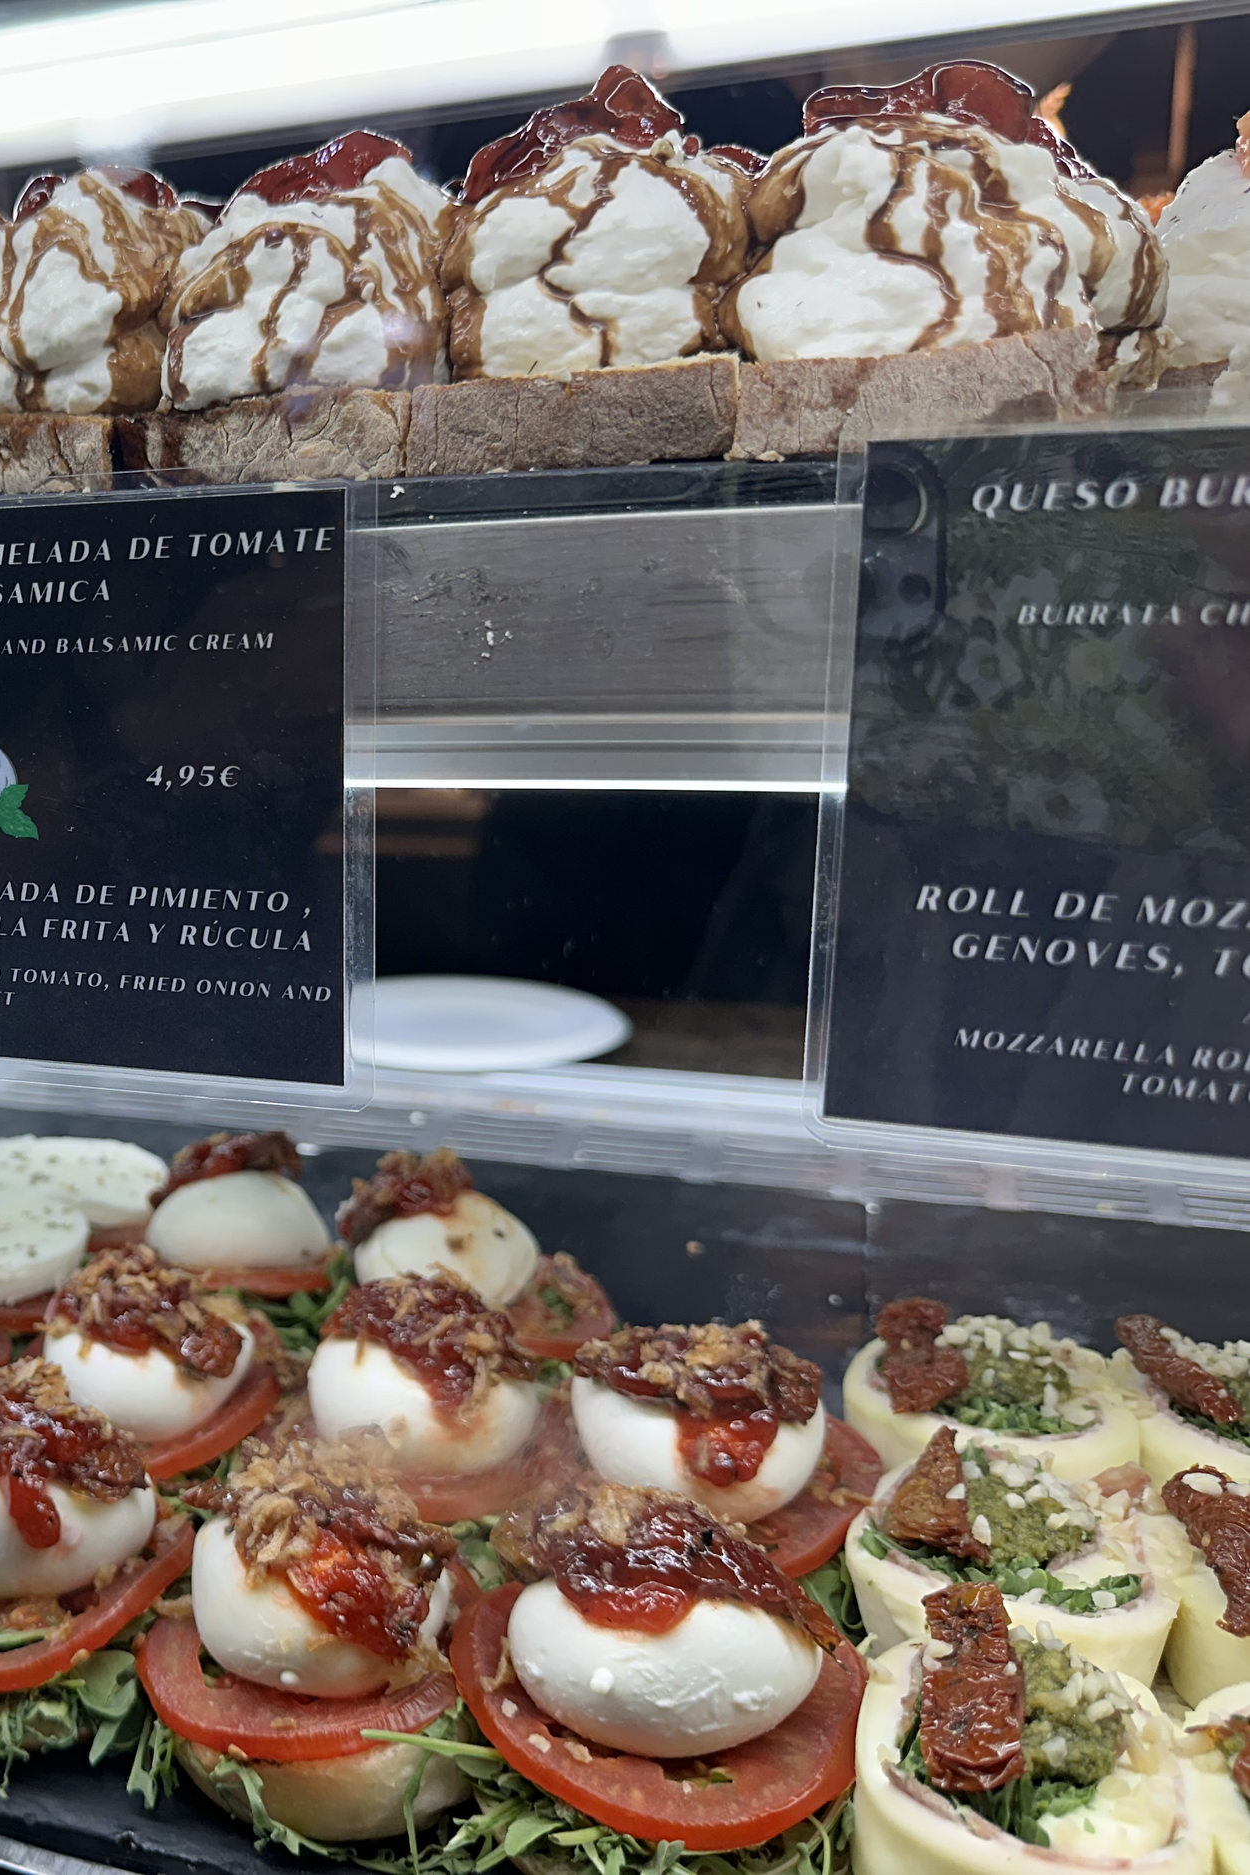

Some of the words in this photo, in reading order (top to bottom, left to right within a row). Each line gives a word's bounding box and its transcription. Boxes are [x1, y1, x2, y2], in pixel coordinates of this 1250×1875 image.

[971, 480, 1139, 519] QUESO
[128, 536, 173, 561] DE
[188, 527, 336, 558] TOMATE
[1017, 603, 1181, 627] BURRATA
[1, 638, 46, 656] AND
[55, 634, 179, 654] BALSAMIC
[188, 632, 275, 651] CREAM
[146, 764, 241, 792] 4,95€
[75, 884, 117, 906] DE
[129, 885, 290, 913] PIMIENTO
[915, 884, 1030, 918] ROLL
[1053, 891, 1119, 922] DE
[42, 918, 130, 943] FRITA
[148, 923, 166, 944] Y
[179, 920, 311, 952] RÚCULA
[952, 932, 1184, 980] GENOVES,
[10, 967, 109, 992] TOMATO,
[119, 974, 186, 993] FRIED
[196, 979, 272, 999] ONION
[281, 984, 332, 1002] AND
[954, 1027, 1175, 1067] MOZZARELLA
